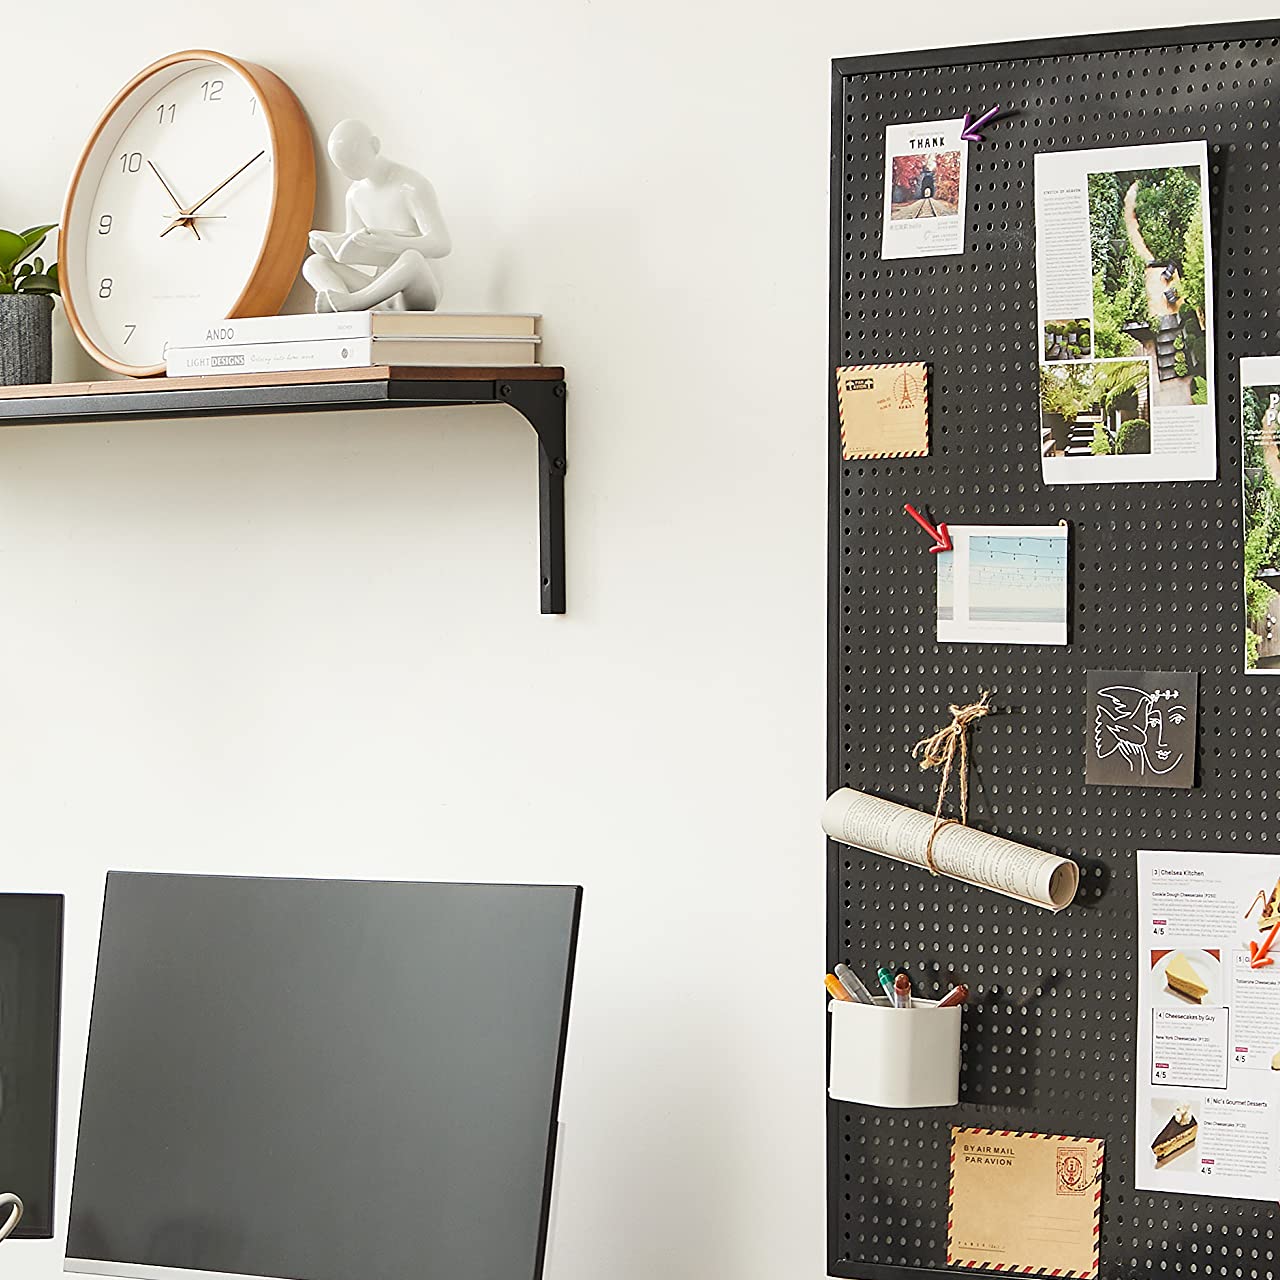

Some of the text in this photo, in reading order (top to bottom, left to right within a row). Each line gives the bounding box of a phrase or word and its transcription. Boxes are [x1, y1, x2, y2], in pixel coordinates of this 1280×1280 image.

[201, 81, 224, 101] 12
[156, 104, 176, 124] 11
[250, 96, 256, 116] 1
[910, 136, 945, 149] THANK
[120, 152, 142, 172] 10
[98, 214, 112, 234] 9
[99, 278, 112, 298] 8
[124, 324, 136, 344] 7
[206, 328, 234, 341] ANDO
[212, 355, 245, 367] DESIGNS
[994, 1147, 1015, 1155] MAIL
